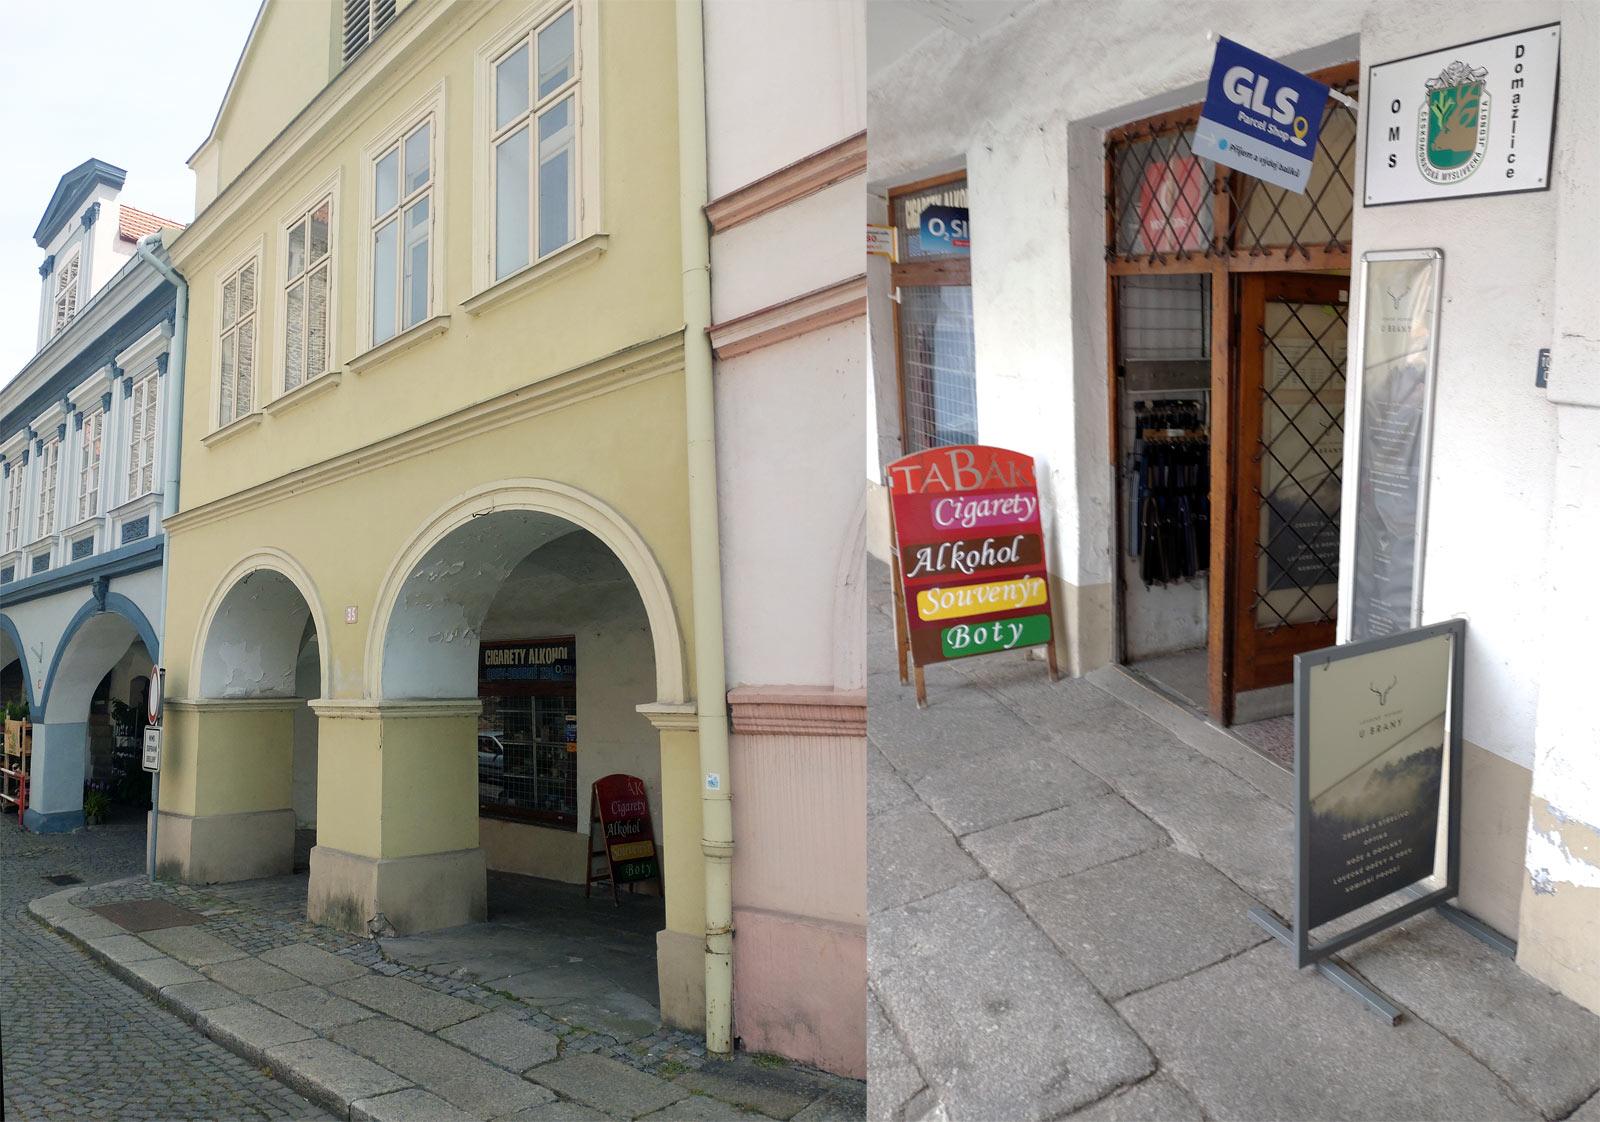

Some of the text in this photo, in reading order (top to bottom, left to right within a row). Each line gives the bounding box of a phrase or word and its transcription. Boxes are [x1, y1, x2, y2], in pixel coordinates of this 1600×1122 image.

[1222, 65, 1300, 126] GLS
[1506, 44, 1525, 178] Domažlice
[1237, 110, 1291, 143] Parcel Shop
[935, 495, 1037, 529] Cigarety
[907, 535, 1025, 578] Alkohol
[921, 574, 1045, 616] Souvenýr
[946, 621, 1024, 650] Boty
[485, 648, 527, 666] CIGARETY
[611, 799, 647, 817] Cigarety
[606, 818, 641, 839] Alkohol
[625, 861, 653, 877] Boty
